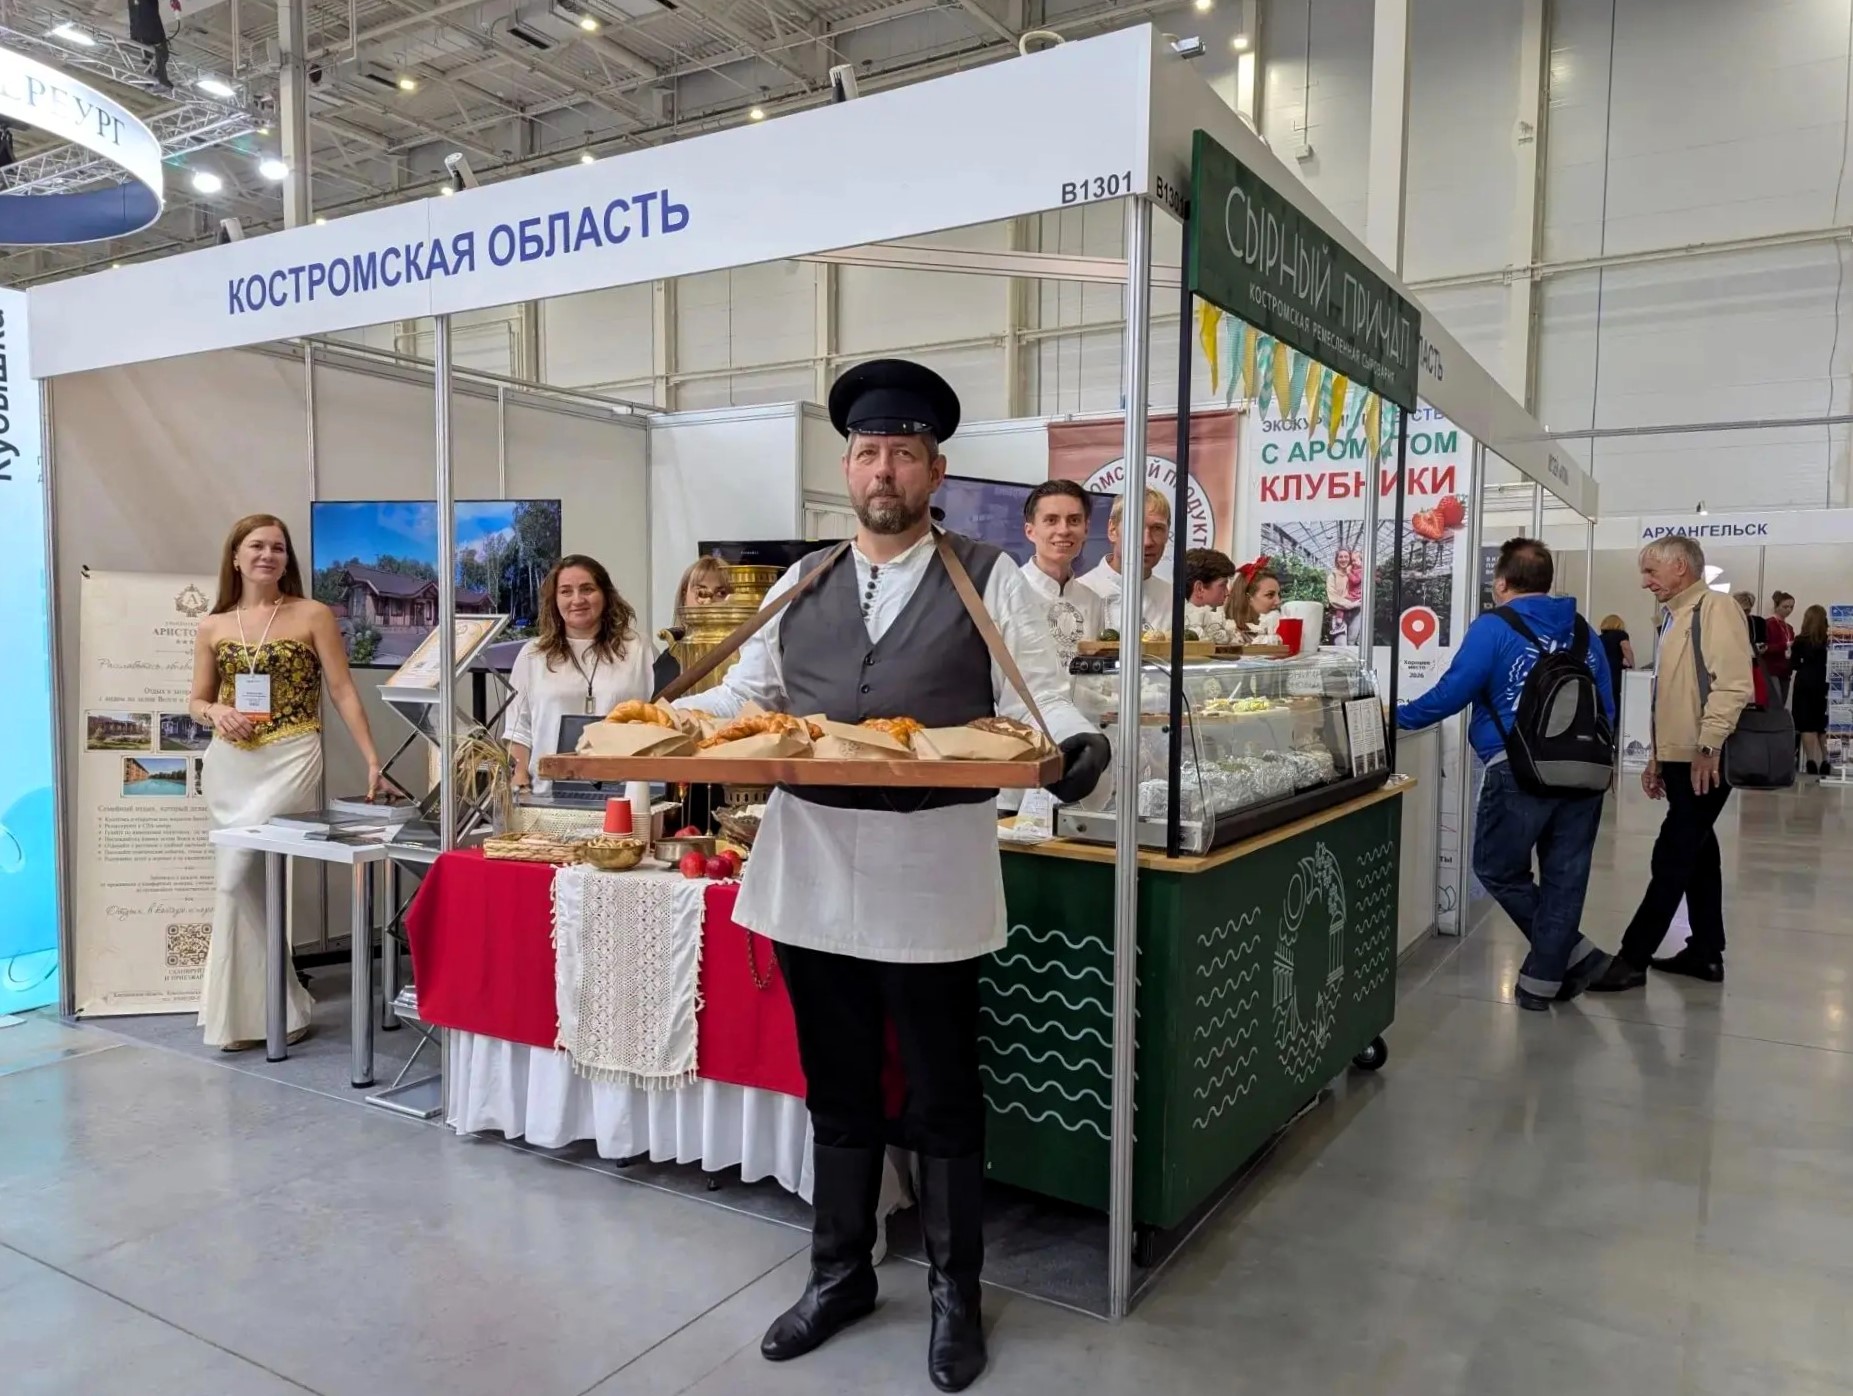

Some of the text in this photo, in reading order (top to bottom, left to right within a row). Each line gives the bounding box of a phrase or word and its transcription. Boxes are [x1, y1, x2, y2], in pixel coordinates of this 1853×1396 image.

[1061, 170, 1132, 205] B1301
[227, 189, 691, 316] КОСТРОМСКАЯ ОБЛАСТЬ
[1225, 186, 1331, 317] СЫРНЫЙ
[1249, 282, 1310, 332] КОСТРОМСКАЯ
[1261, 443, 1279, 464] С
[1162, 469, 1208, 546] ПОДУКТ
[1642, 523, 1768, 539] АРХАНГЕЛЬСК
[152, 628, 197, 637] АРИСТО
